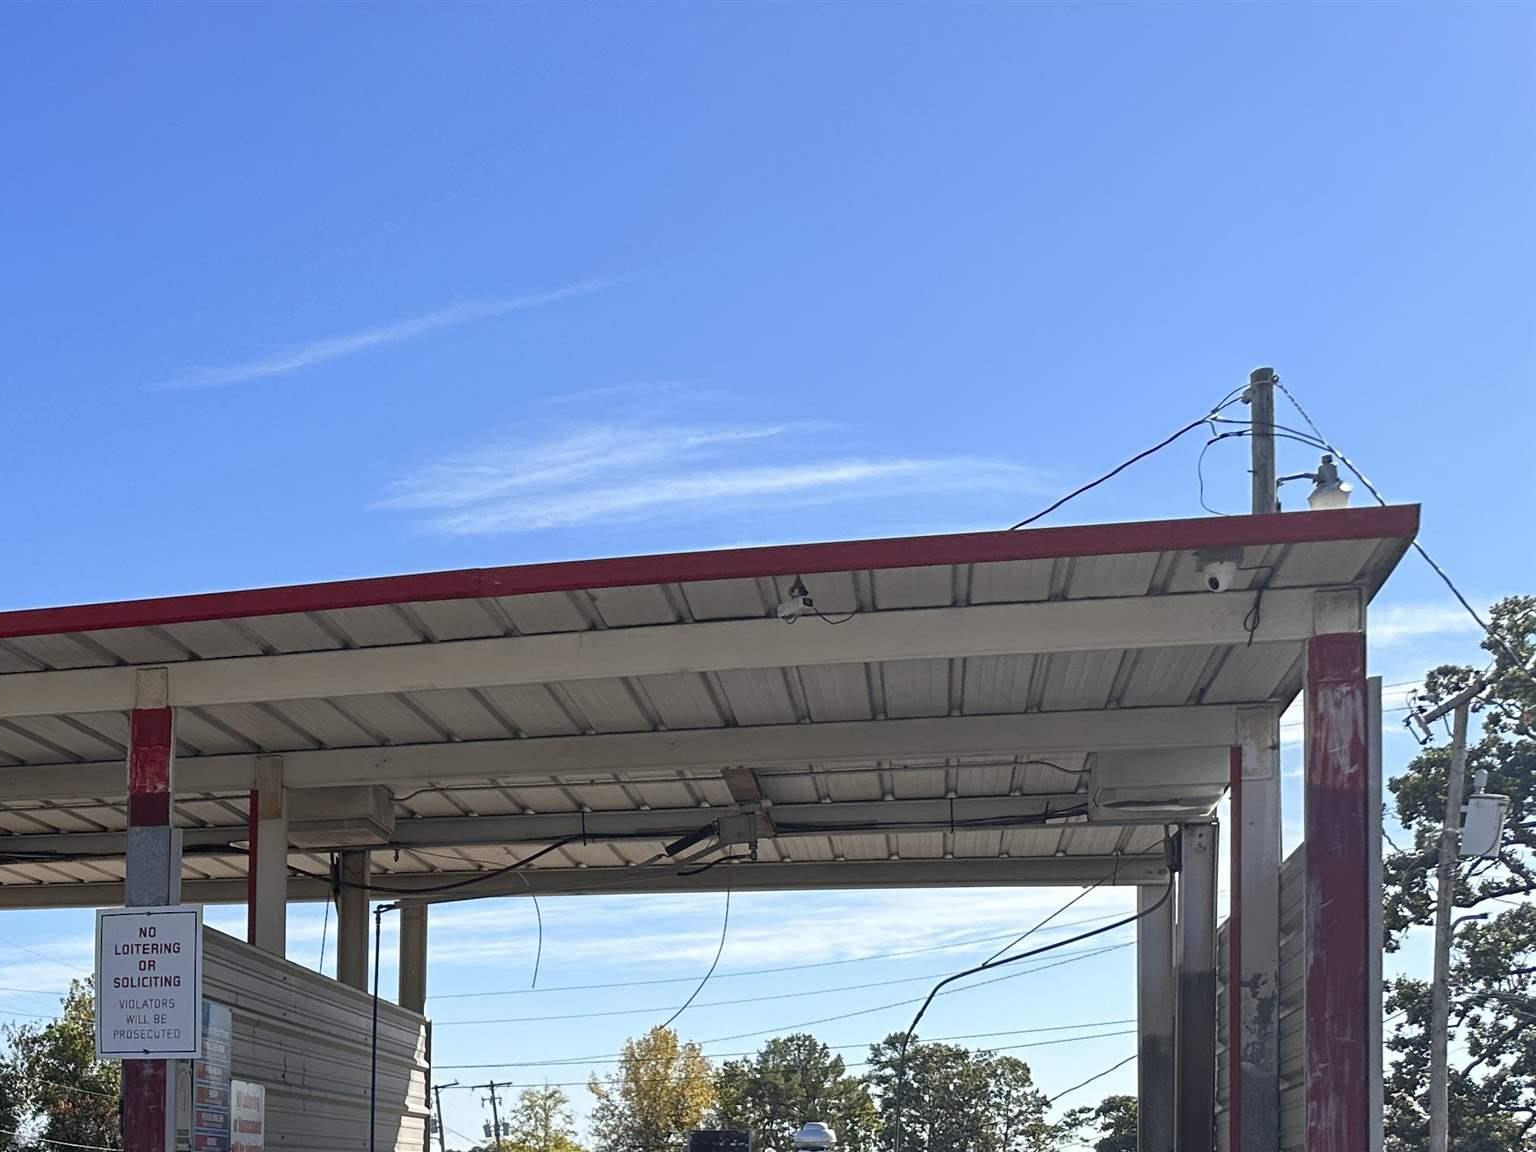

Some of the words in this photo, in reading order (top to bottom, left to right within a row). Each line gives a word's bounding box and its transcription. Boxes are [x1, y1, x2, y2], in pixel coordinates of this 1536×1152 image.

[139, 926, 157, 938] NO
[114, 942, 181, 956] LOITERING
[138, 960, 156, 972] OR
[113, 975, 181, 989] SOLICITING
[119, 998, 175, 1009] VIOLATORS
[126, 1014, 149, 1025] WILL
[153, 1013, 167, 1024] BE
[113, 1028, 181, 1040] PROSECUTED
